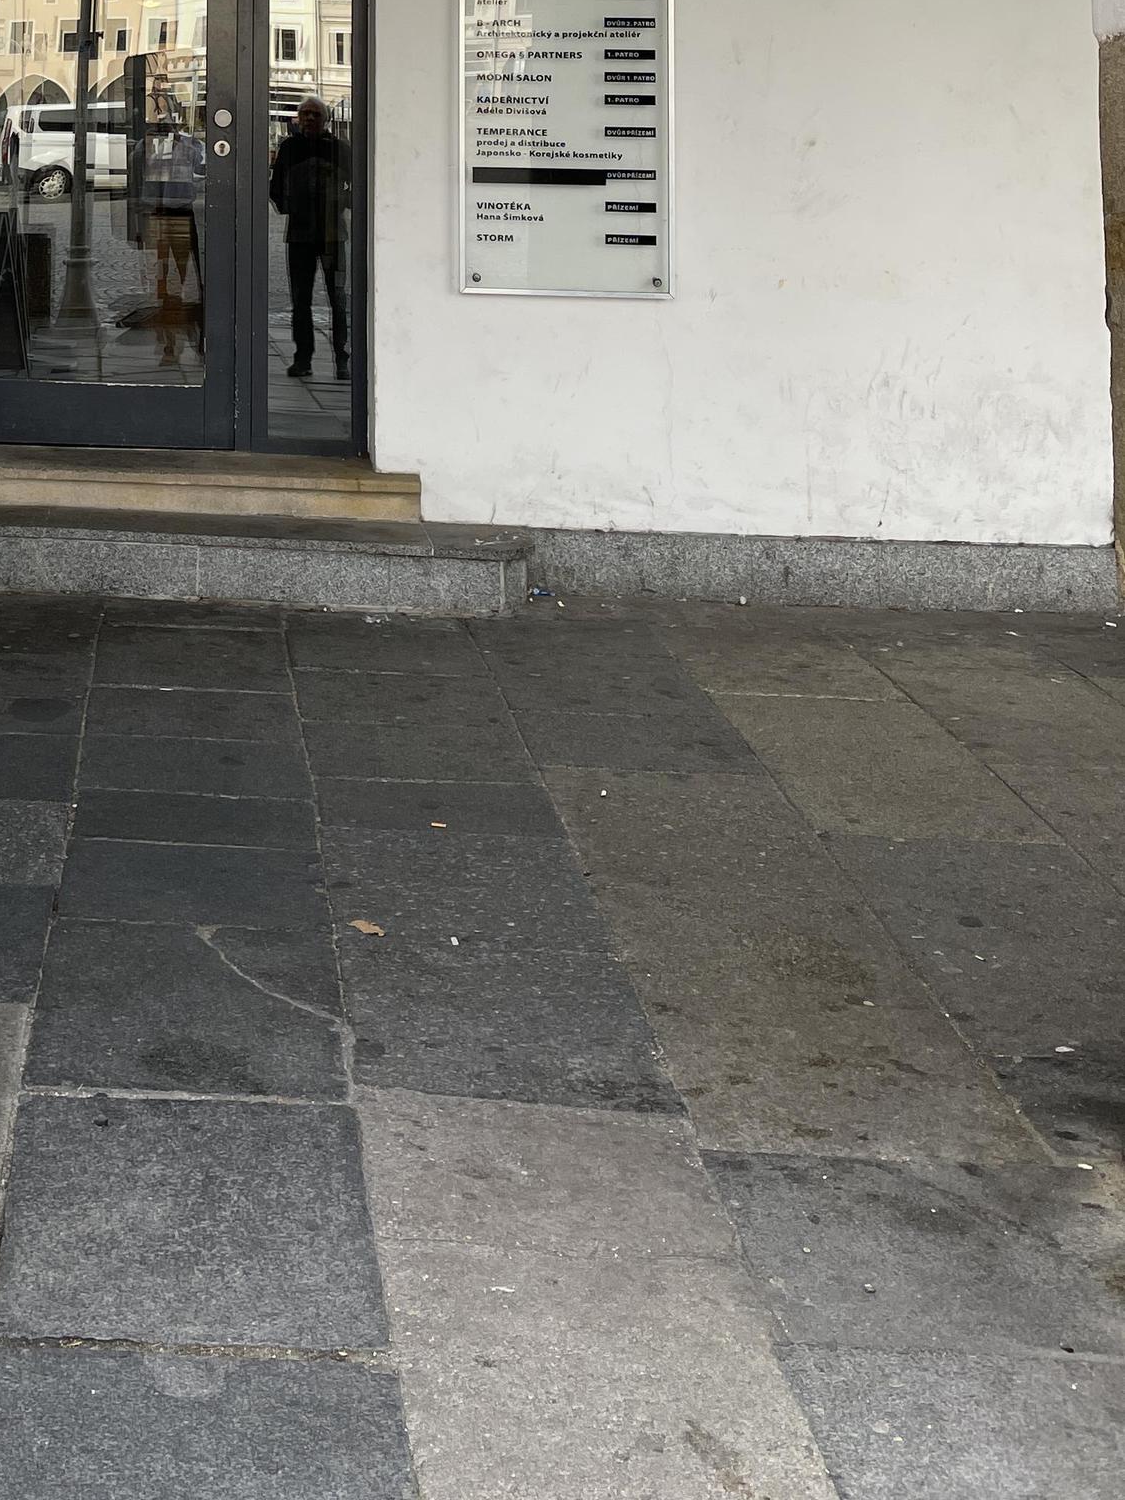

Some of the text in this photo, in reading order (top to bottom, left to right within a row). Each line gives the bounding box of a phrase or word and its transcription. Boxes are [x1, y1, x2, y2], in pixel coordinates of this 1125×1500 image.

[492, 19, 522, 27] ARCH
[562, 30, 608, 39] projekční
[609, 30, 641, 38] ateliér
[476, 51, 516, 59] OMEGA
[527, 51, 583, 59] PARTNERS
[476, 73, 552, 82] MODNÍ SALON
[476, 95, 550, 105] KADEŘNICTVÍ
[506, 106, 547, 116] Divišová
[476, 127, 548, 137] TEMPERANCE
[476, 139, 508, 148] prodej
[518, 139, 566, 148] distribuce
[476, 149, 623, 161] Japonsko Korejské kosmetiky
[476, 201, 531, 211] VINOTÉKA
[476, 213, 501, 221] Hana
[476, 234, 514, 242] STORM
